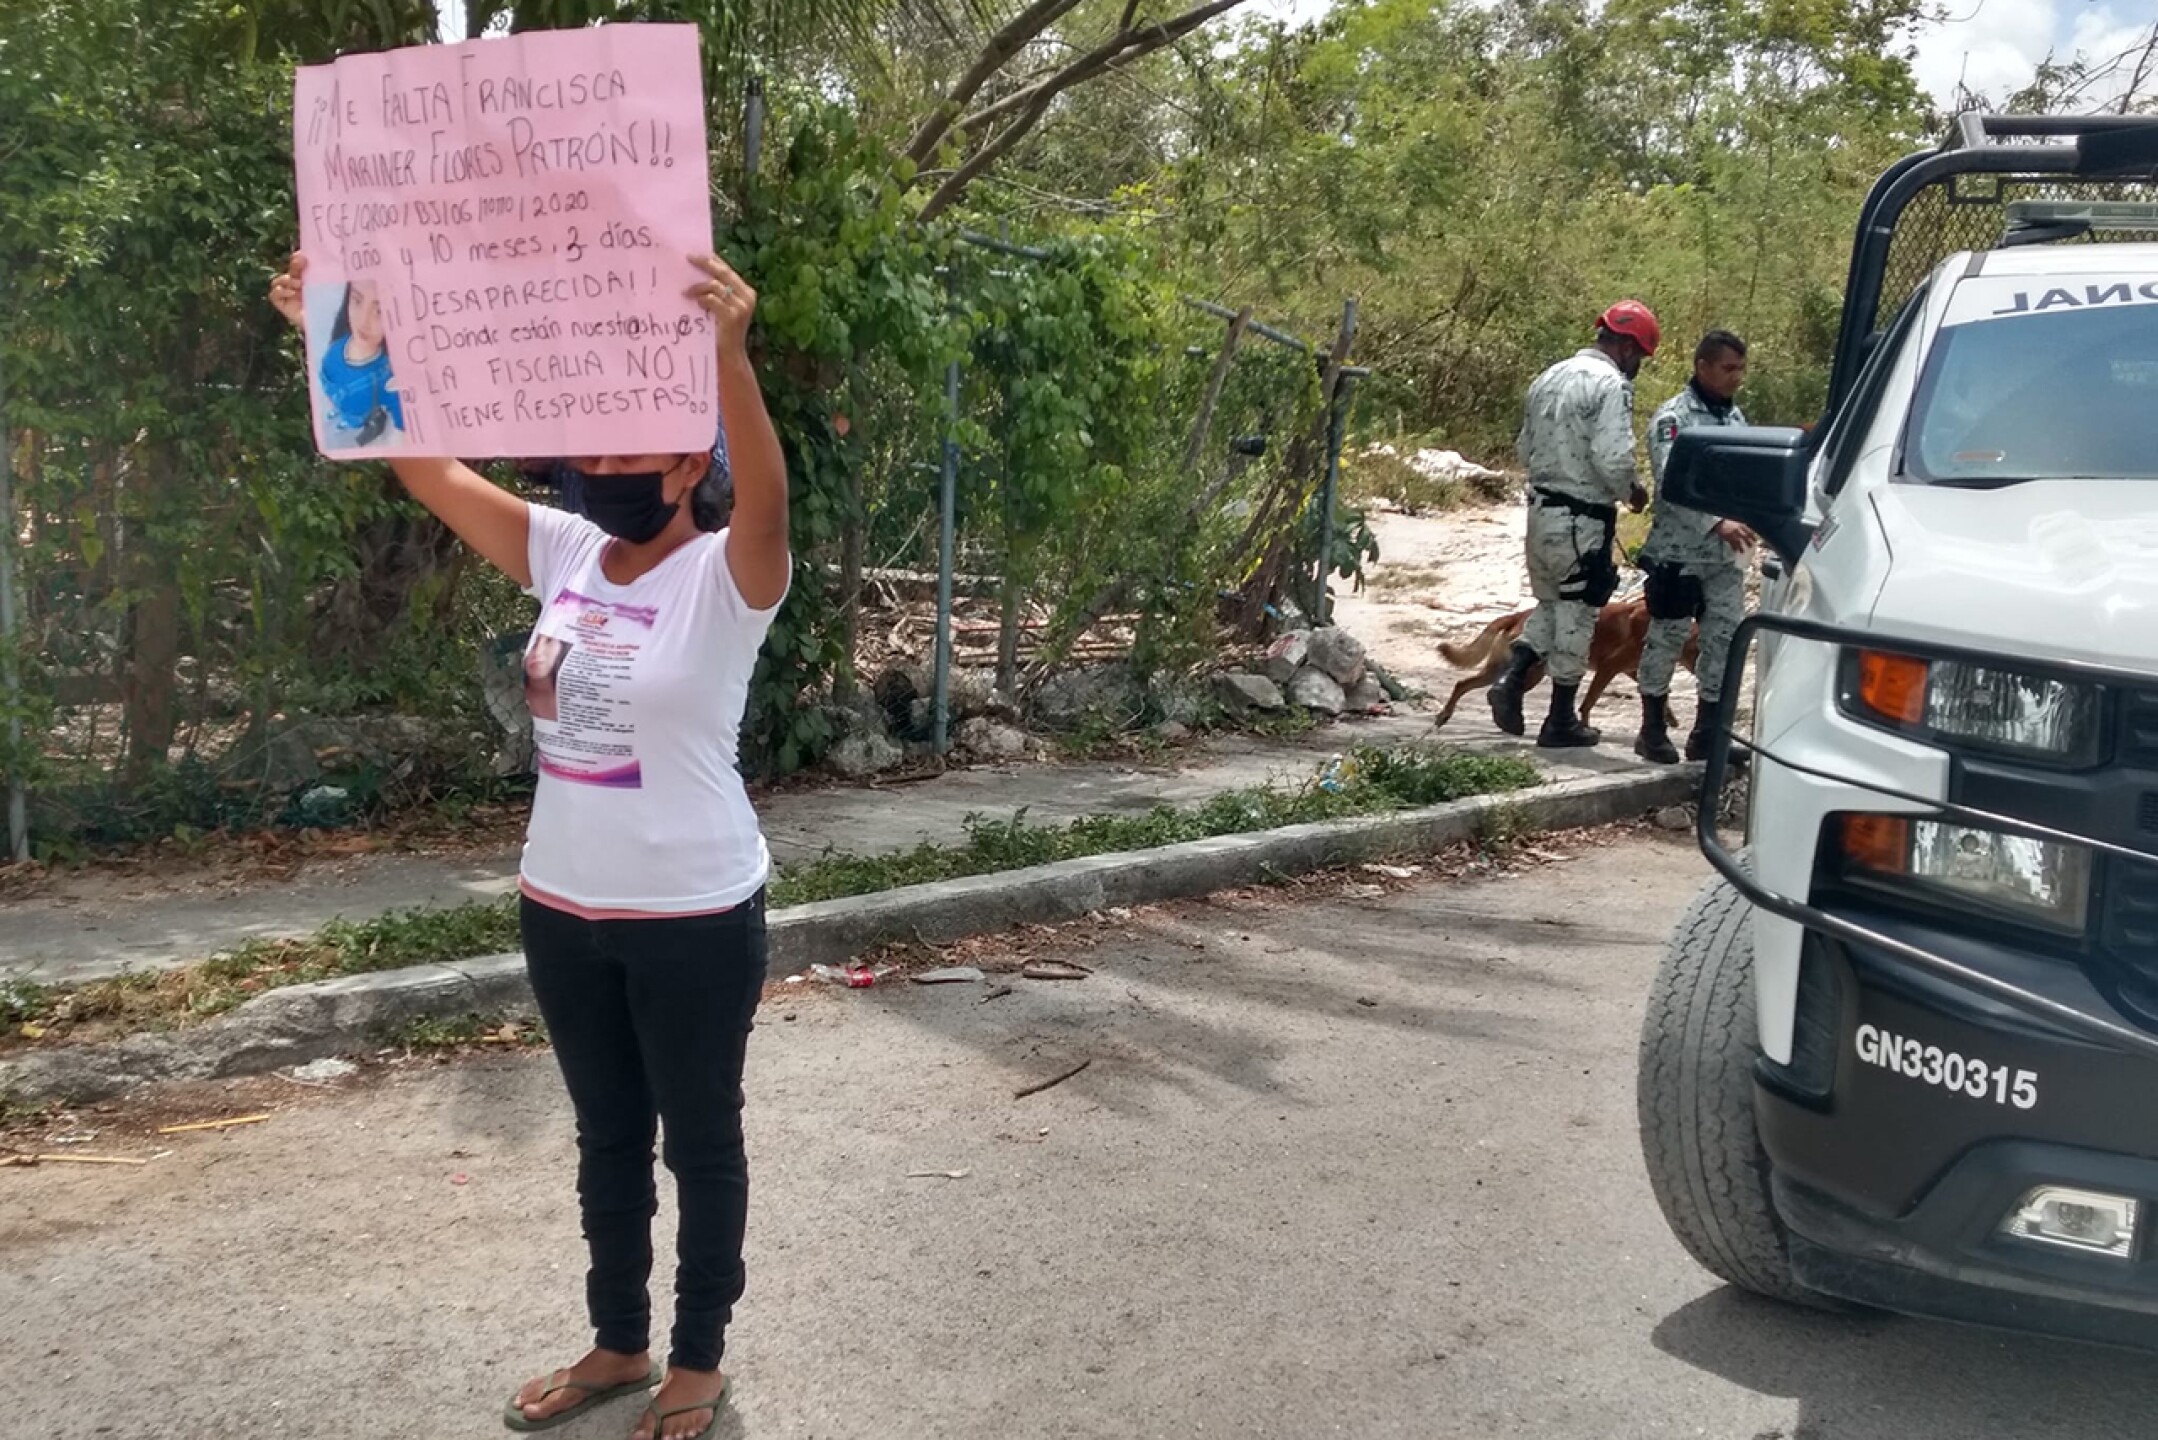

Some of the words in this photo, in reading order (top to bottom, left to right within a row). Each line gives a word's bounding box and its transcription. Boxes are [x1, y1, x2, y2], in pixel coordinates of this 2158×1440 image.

[382, 74, 453, 128] FALTA
[461, 54, 626, 124] FRANCISCA
[324, 143, 417, 193] MARINER
[431, 130, 503, 184] FLORES
[351, 242, 381, 270] año
[401, 247, 415, 281] y
[429, 232, 453, 264] 10
[425, 365, 458, 394] LA
[626, 344, 675, 381] NO
[440, 402, 504, 429] TIENE
[1855, 1024, 2038, 1109] GN330315
